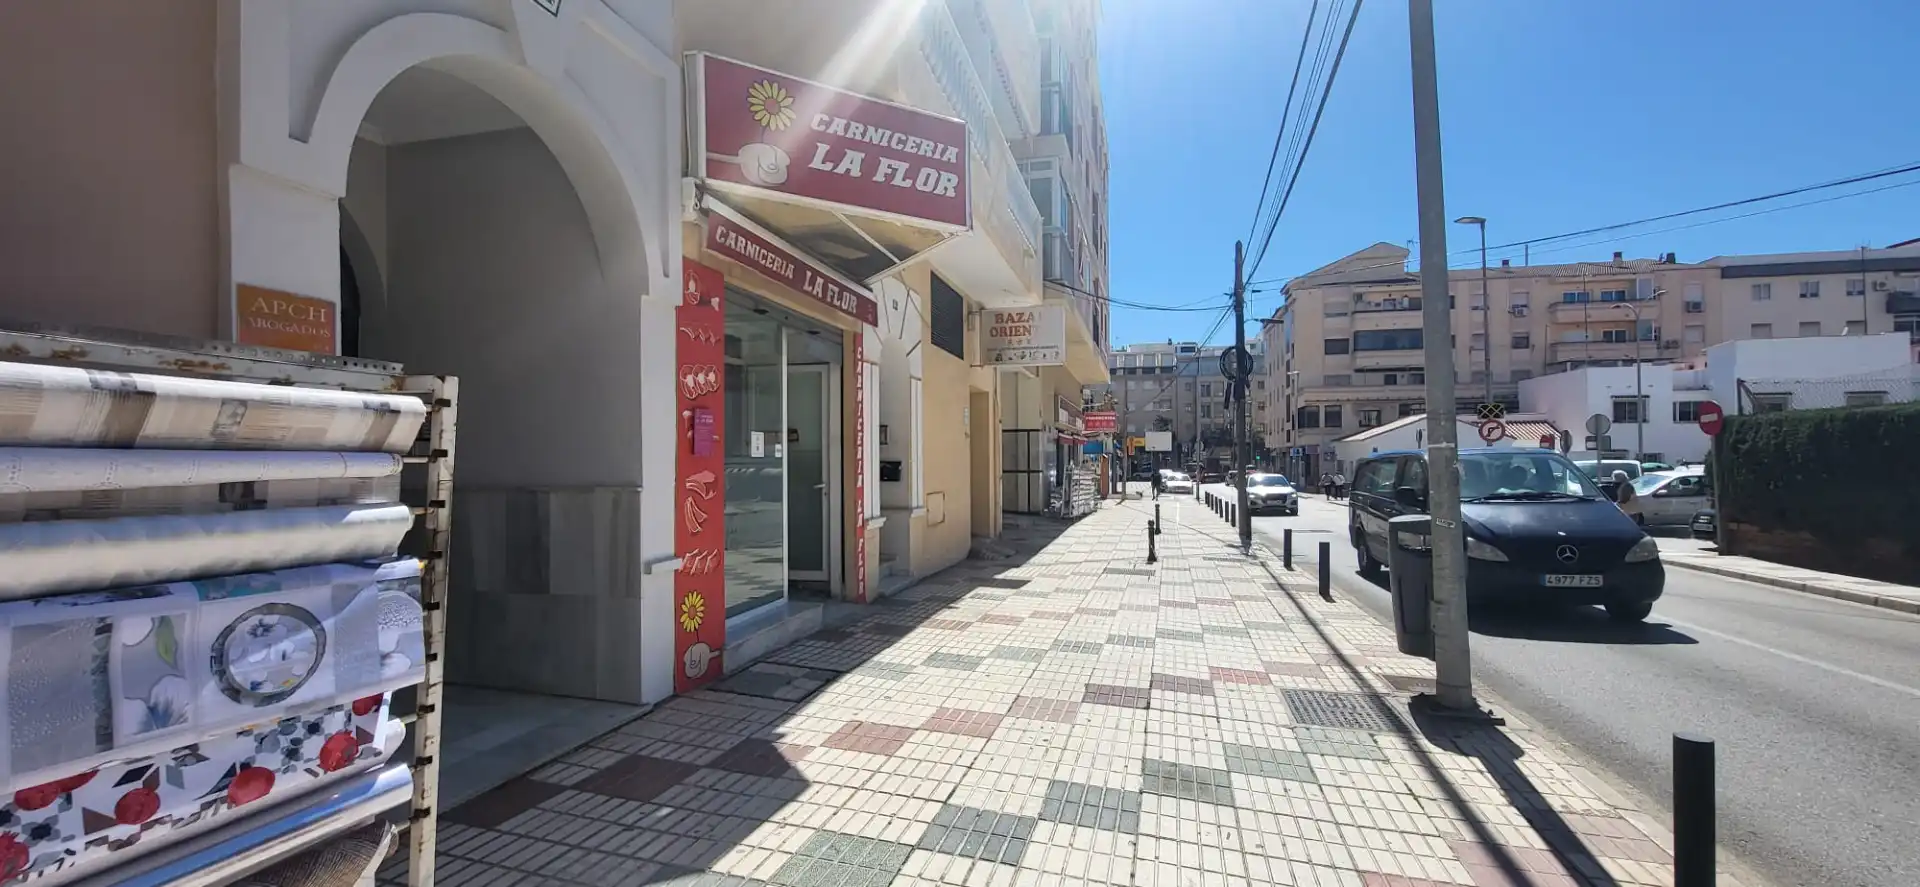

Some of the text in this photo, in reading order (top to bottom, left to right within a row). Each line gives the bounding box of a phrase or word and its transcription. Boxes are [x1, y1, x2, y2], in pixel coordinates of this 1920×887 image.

[810, 113, 959, 164] CARNICERIA
[808, 142, 959, 198] LA FLOR
[715, 225, 795, 280] CARNICERIA
[802, 270, 825, 300] LA
[827, 284, 858, 314] FLOR
[250, 296, 327, 323] APCH
[856, 346, 865, 595] CARNICERIA LA FLOR
[1546, 575, 1575, 585] 4977
